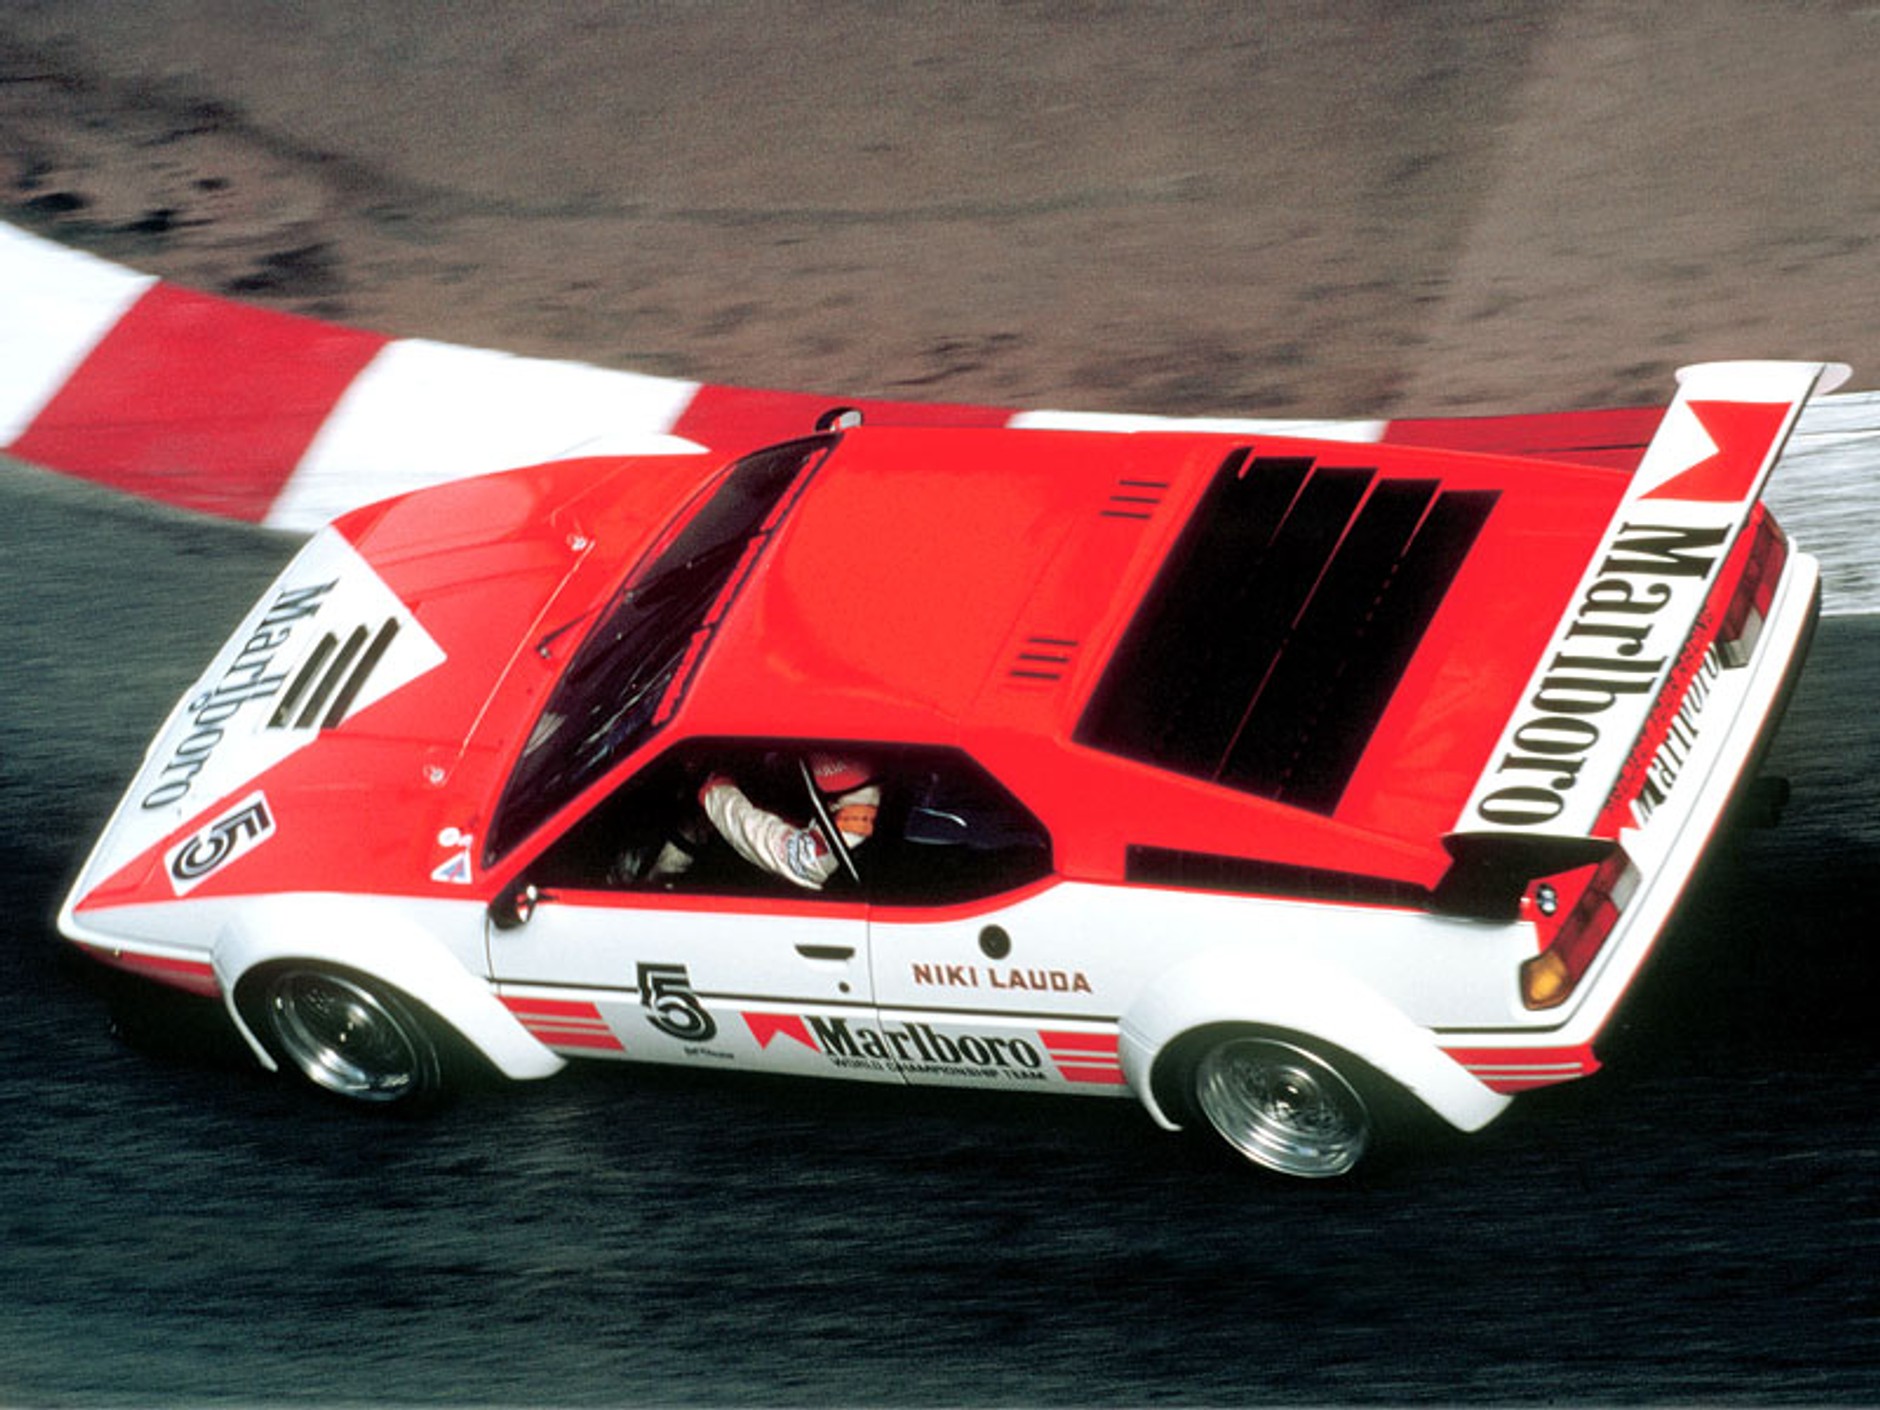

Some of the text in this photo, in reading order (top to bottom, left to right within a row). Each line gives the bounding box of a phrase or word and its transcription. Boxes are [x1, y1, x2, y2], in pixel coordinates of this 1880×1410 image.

[142, 576, 340, 809] Marlboro
[1477, 522, 1734, 826] Marlboro
[172, 801, 271, 880] 5
[636, 962, 717, 1042] 5
[912, 963, 1093, 994] NIKI LAUDA
[804, 1015, 1042, 1069] Marlboro
[1002, 1068, 1048, 1080] TEAM
